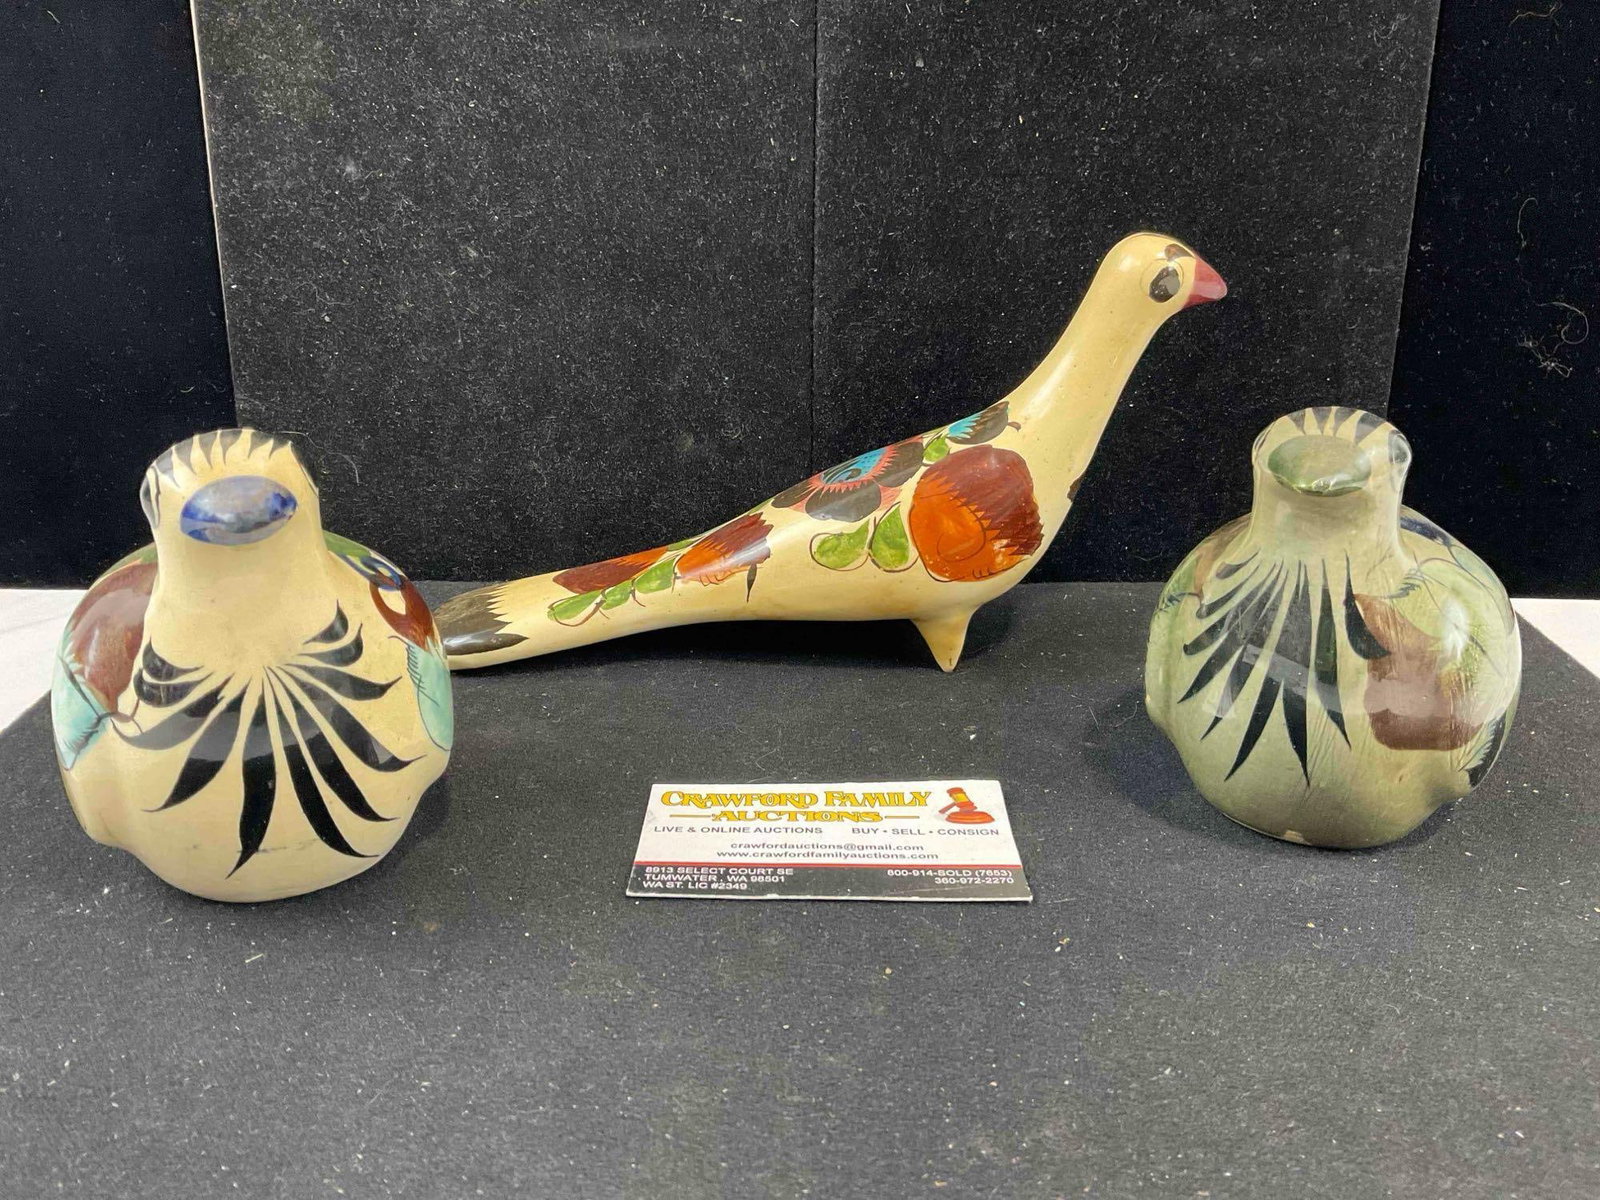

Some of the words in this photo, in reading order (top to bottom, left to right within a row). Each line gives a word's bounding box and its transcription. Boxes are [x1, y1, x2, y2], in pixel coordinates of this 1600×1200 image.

[660, 790, 819, 809] CRAWFORD
[824, 790, 932, 809] FAMILY
[711, 810, 884, 823] AUCTIONS
[700, 826, 751, 834] ONLINE
[753, 826, 823, 834] AUCTIONS
[851, 827, 879, 835] BUY
[891, 828, 925, 836] SELL
[937, 828, 999, 836] CONSIGN
[730, 842, 924, 851] crawfordauctions@gmail.com
[716, 851, 939, 859] www.crawfordfamilyauctions.com
[645, 866, 674, 874] 8913
[676, 867, 727, 875] SELECT
[729, 867, 775, 875] COURT
[776, 868, 794, 876] SE
[642, 881, 664, 889] WA
[688, 881, 708, 889] LIC
[934, 877, 1014, 885] 360-972-2270
